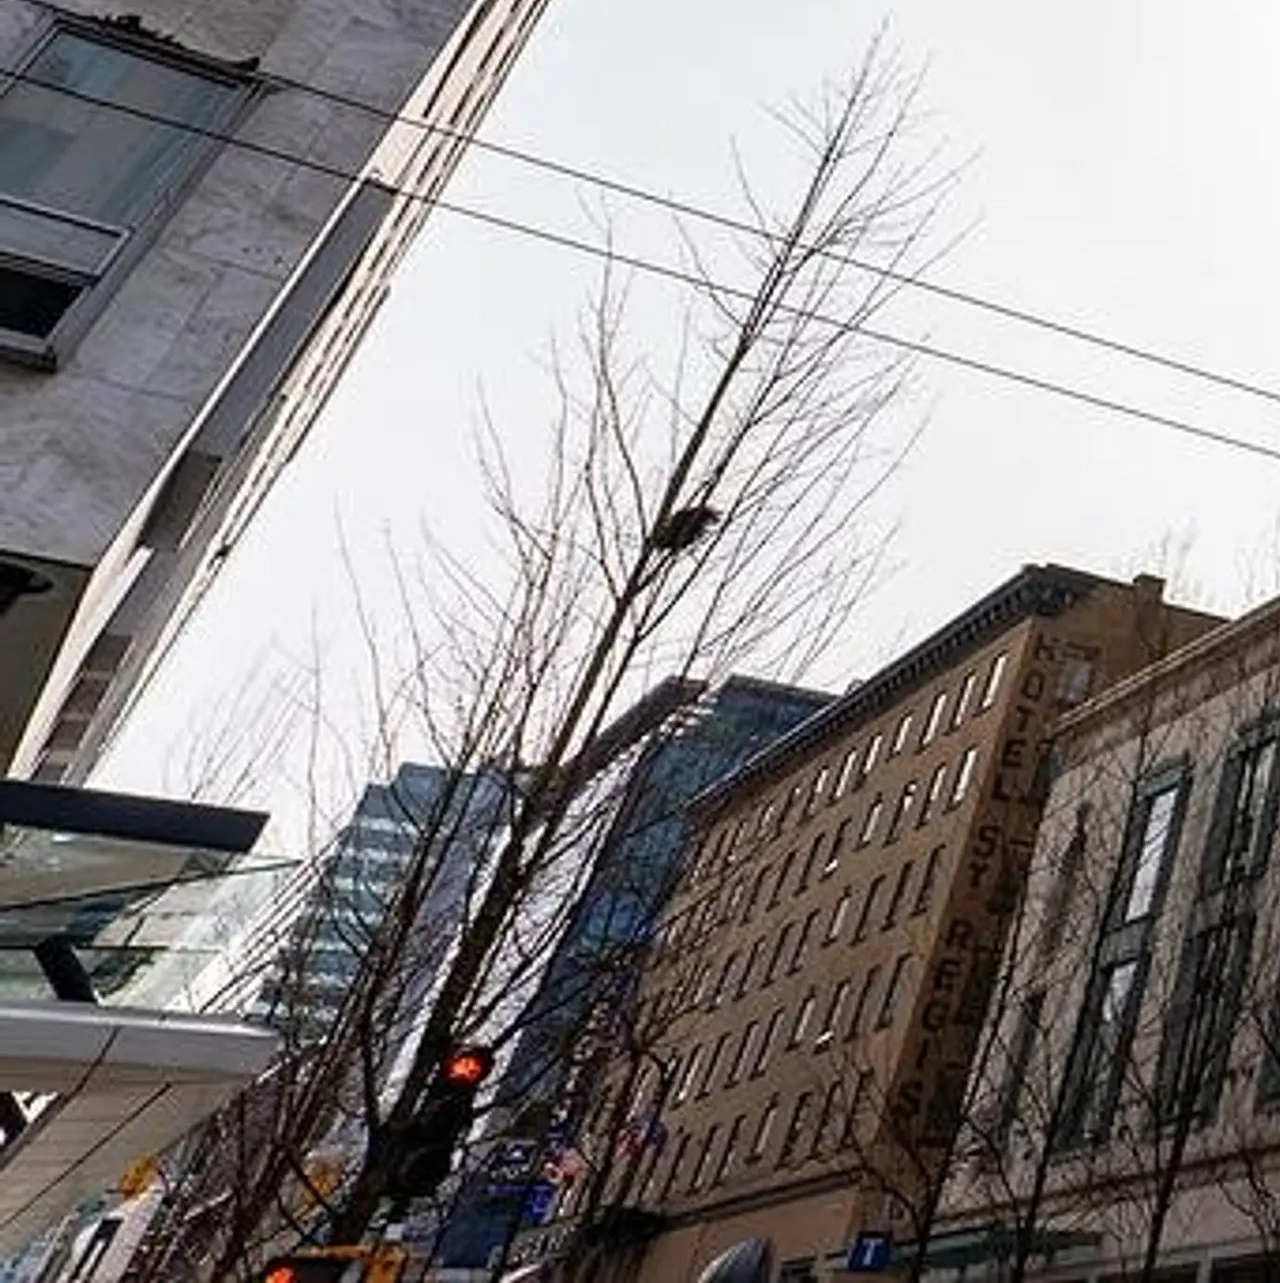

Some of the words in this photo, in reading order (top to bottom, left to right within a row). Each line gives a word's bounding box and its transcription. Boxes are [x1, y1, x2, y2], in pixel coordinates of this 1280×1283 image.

[990, 632, 1057, 803] HOTEL
[966, 822, 1002, 888] ST
[889, 918, 973, 1116] REGIS
